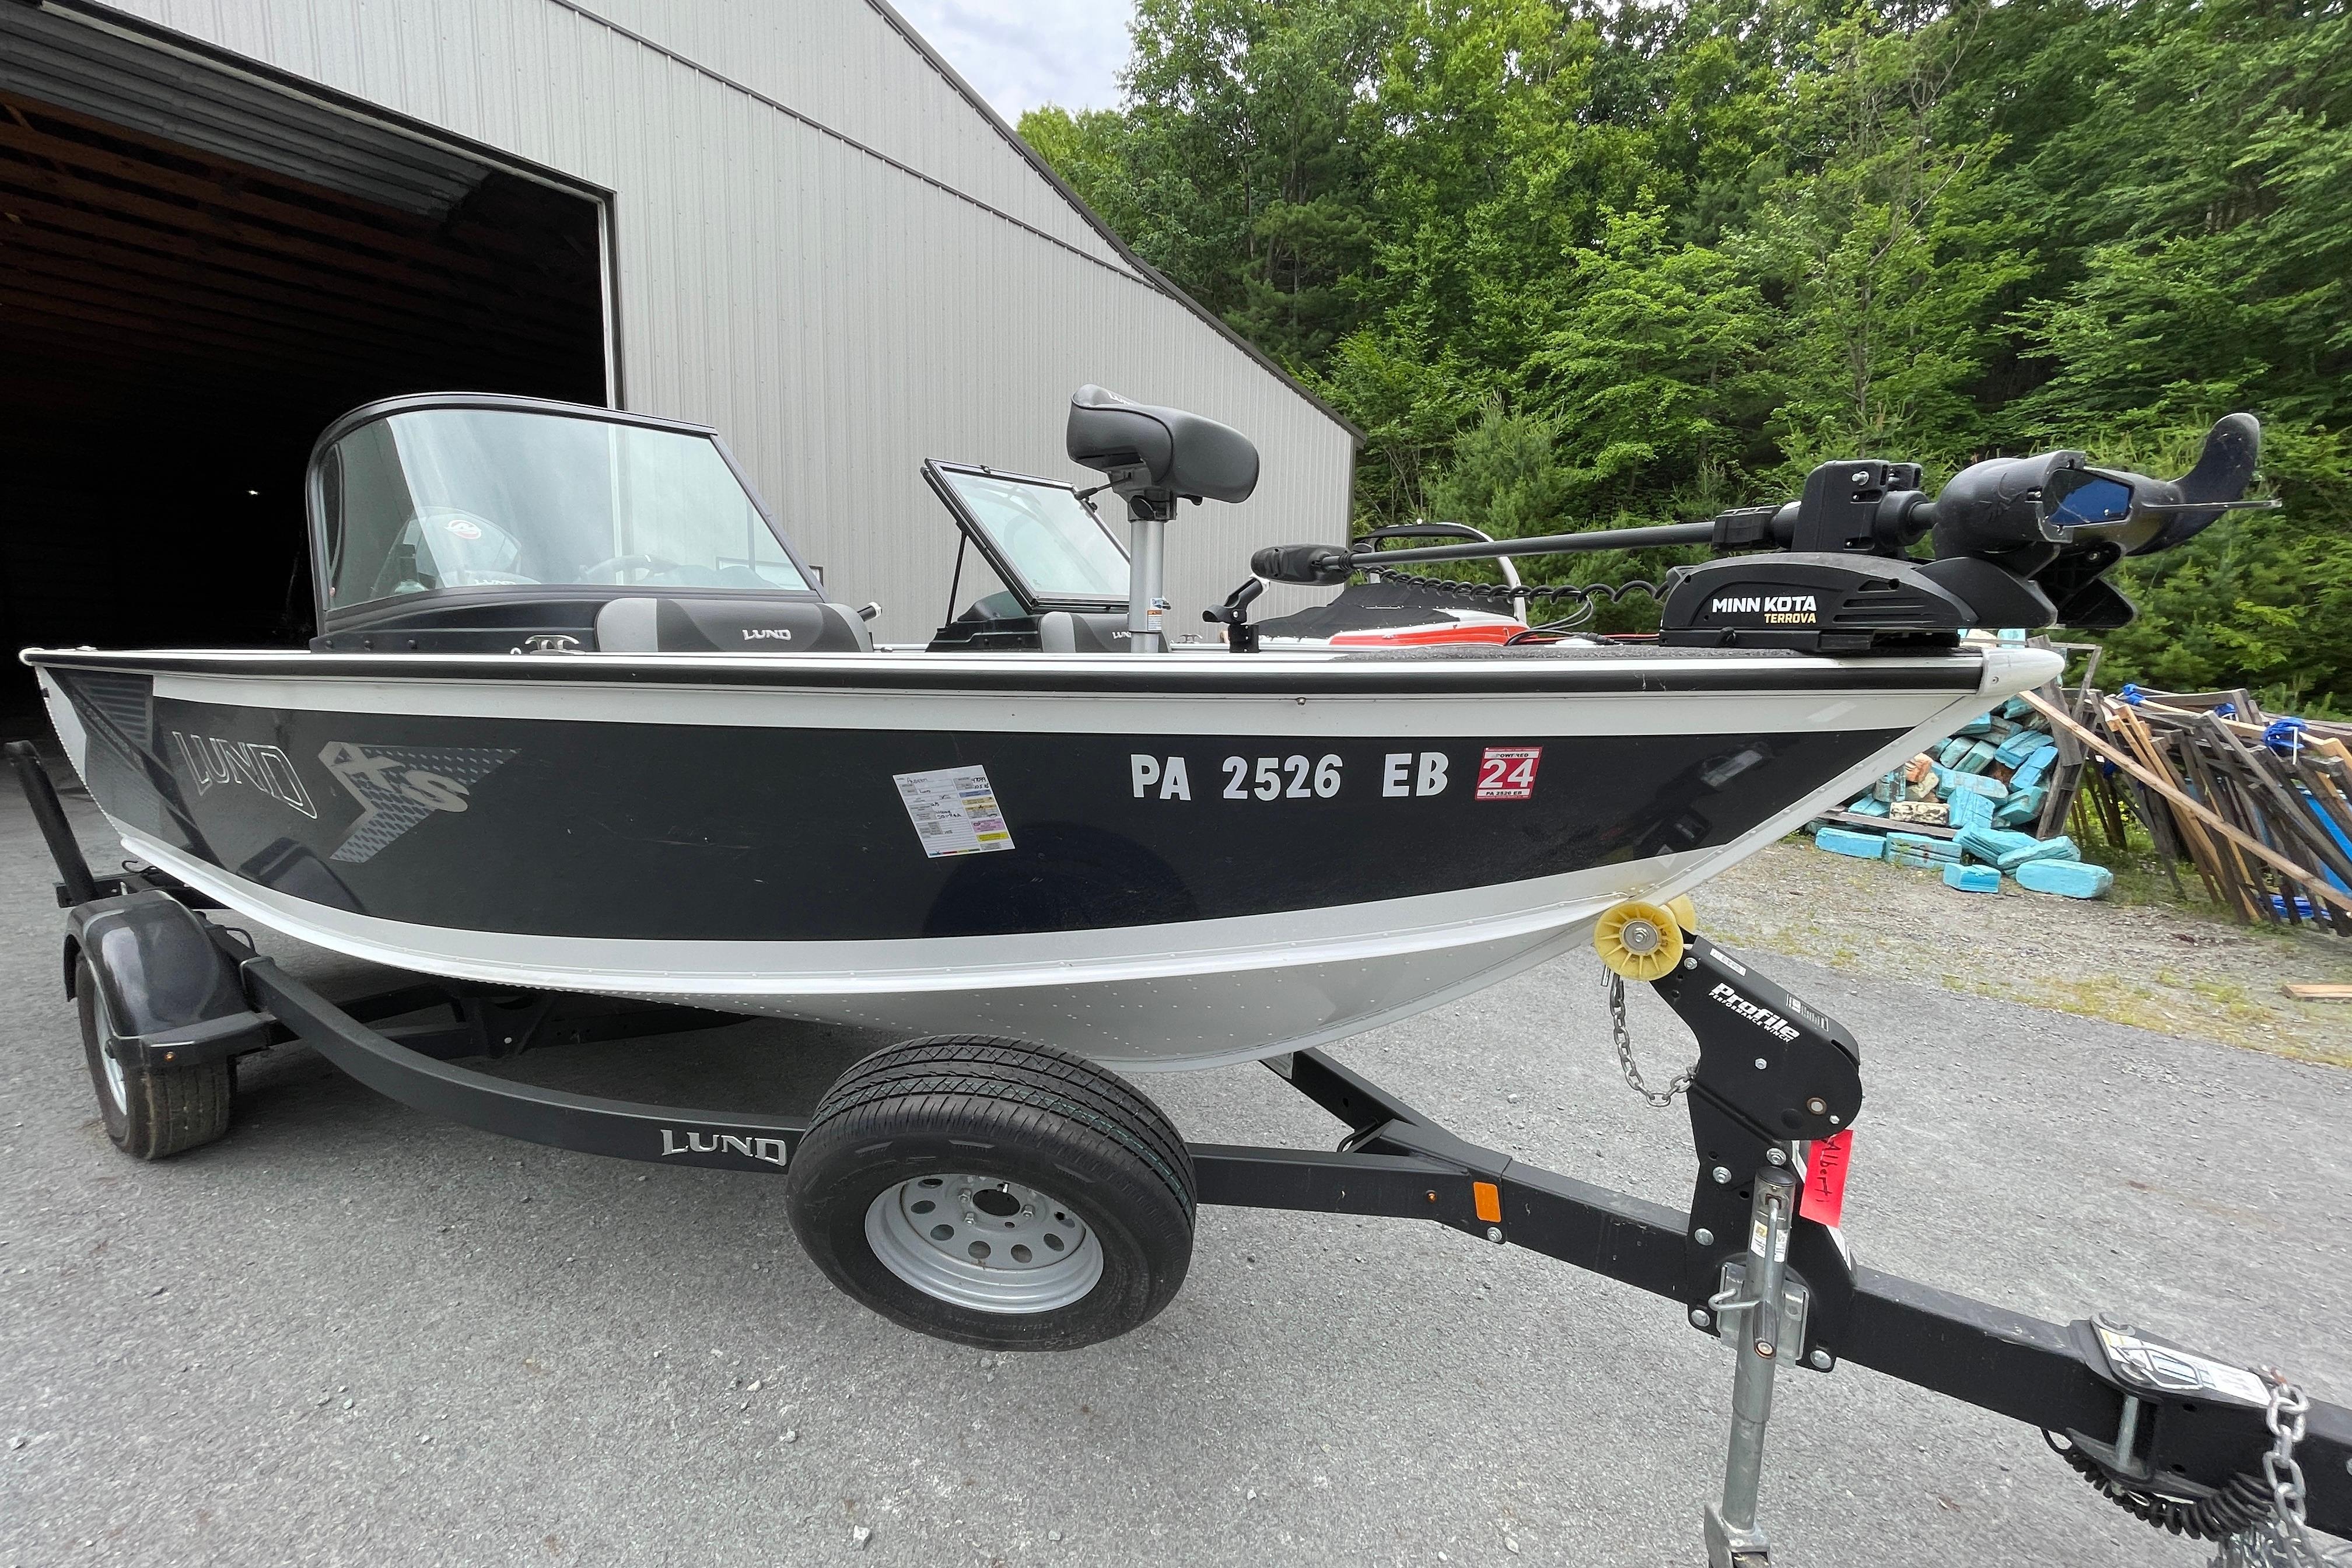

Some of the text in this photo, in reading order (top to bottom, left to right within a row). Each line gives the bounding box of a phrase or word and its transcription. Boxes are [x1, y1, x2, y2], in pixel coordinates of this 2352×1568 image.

[1712, 596, 1817, 612] MINN KOTA
[1764, 612, 1816, 624] TERROVA
[742, 629, 792, 641] LUND
[172, 731, 317, 820] LUND
[1130, 752, 1449, 802] PA 2526 EB
[1478, 758, 1534, 788] 24
[1708, 992, 1763, 1027] PERFORMANCE
[1763, 1024, 1791, 1043] WINCH
[1710, 982, 1801, 1040] Profile
[660, 1129, 788, 1167] LUND
